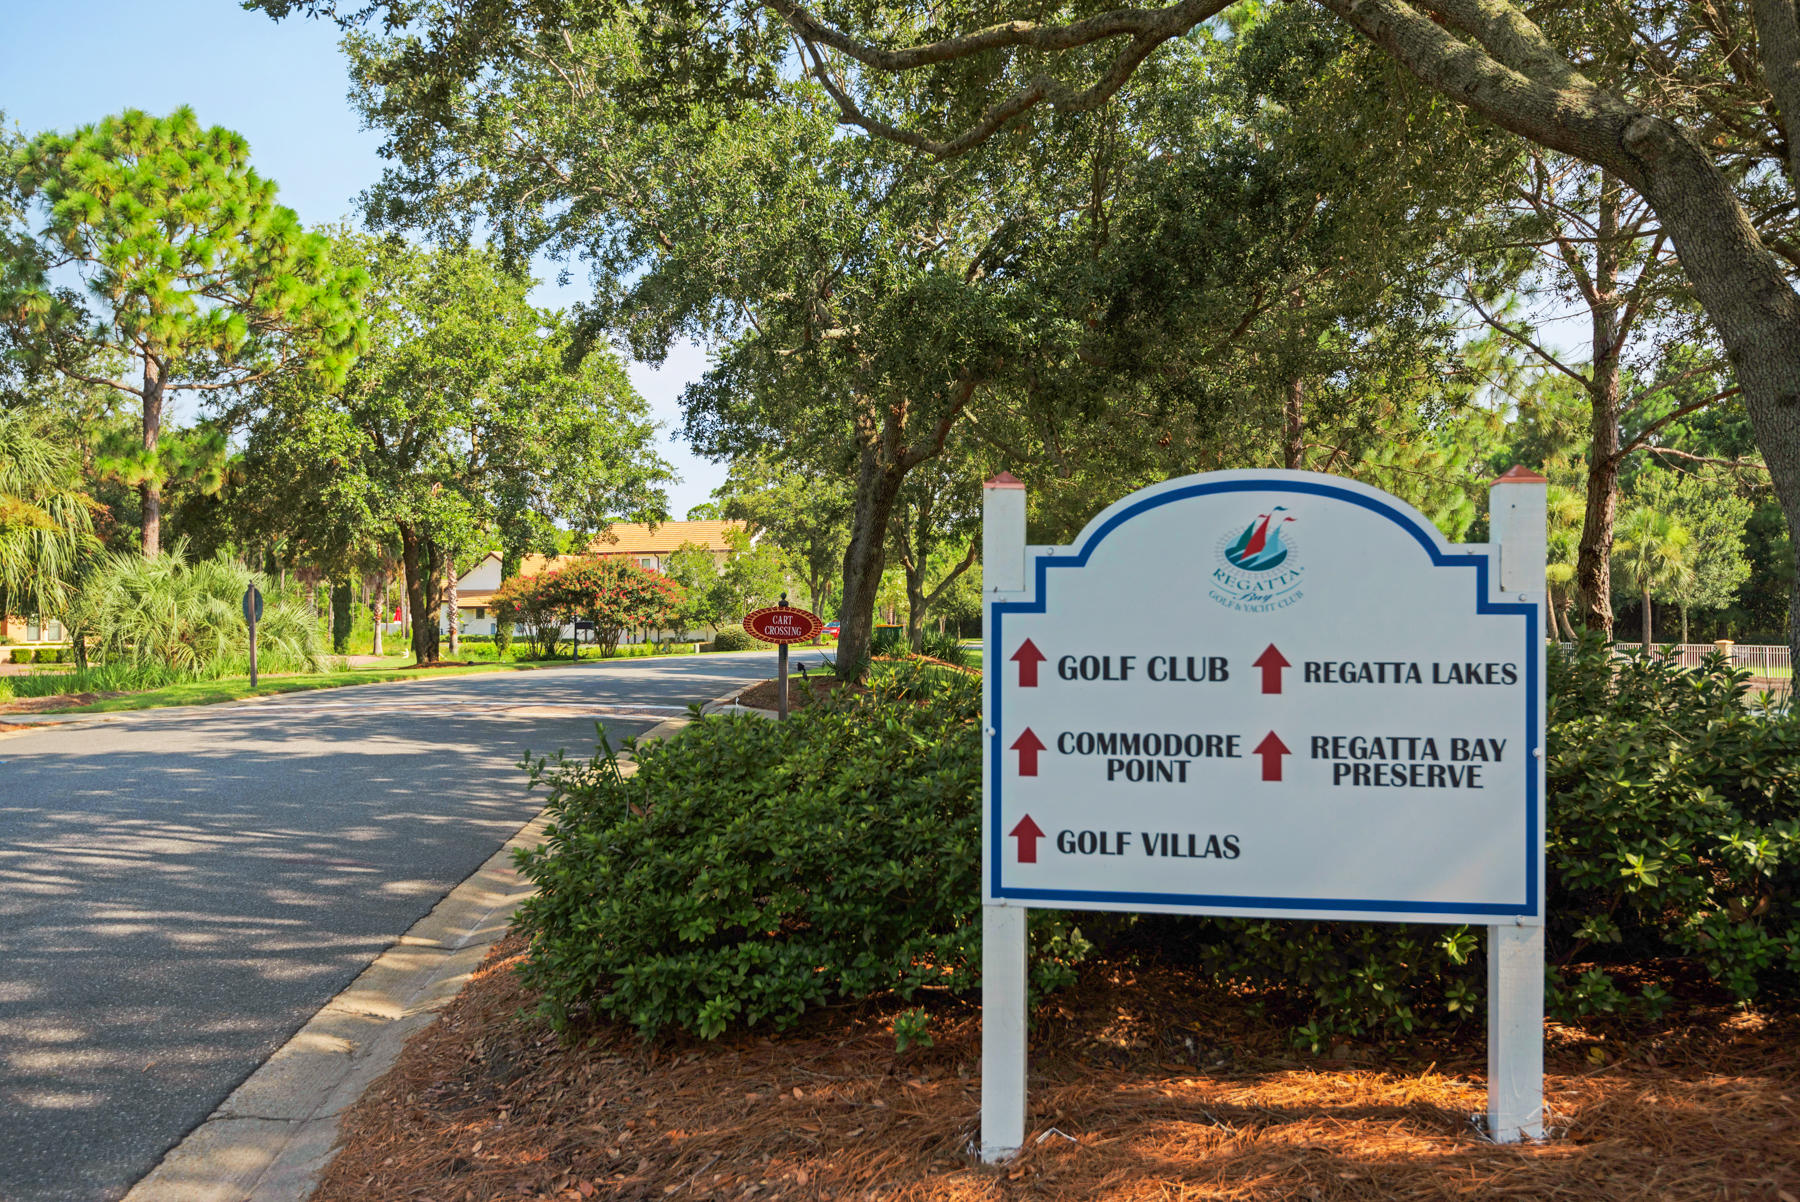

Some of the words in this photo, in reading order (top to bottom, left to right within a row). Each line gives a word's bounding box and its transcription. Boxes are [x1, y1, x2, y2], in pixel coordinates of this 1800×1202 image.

[1212, 568, 1300, 591] REGATTA
[1208, 590, 1233, 609] GOLF
[1243, 604, 1276, 613] YACHT
[1277, 590, 1304, 609] CLUB
[1239, 592, 1273, 603] Bay
[764, 625, 802, 636] CROSSING
[772, 615, 794, 625] CART
[1057, 655, 1137, 681] GOLF
[1147, 656, 1230, 682] CLUB
[1304, 661, 1422, 684] REGATTA
[1432, 662, 1518, 685] LAKES
[1057, 731, 1242, 758] COMMODORE
[1310, 735, 1440, 761] REGATTA
[1450, 737, 1507, 762] BAY
[1107, 758, 1191, 783] POINT
[1333, 762, 1484, 789] PRESERVE
[1056, 829, 1132, 856] GOLF
[1141, 832, 1241, 860] VILLAS
